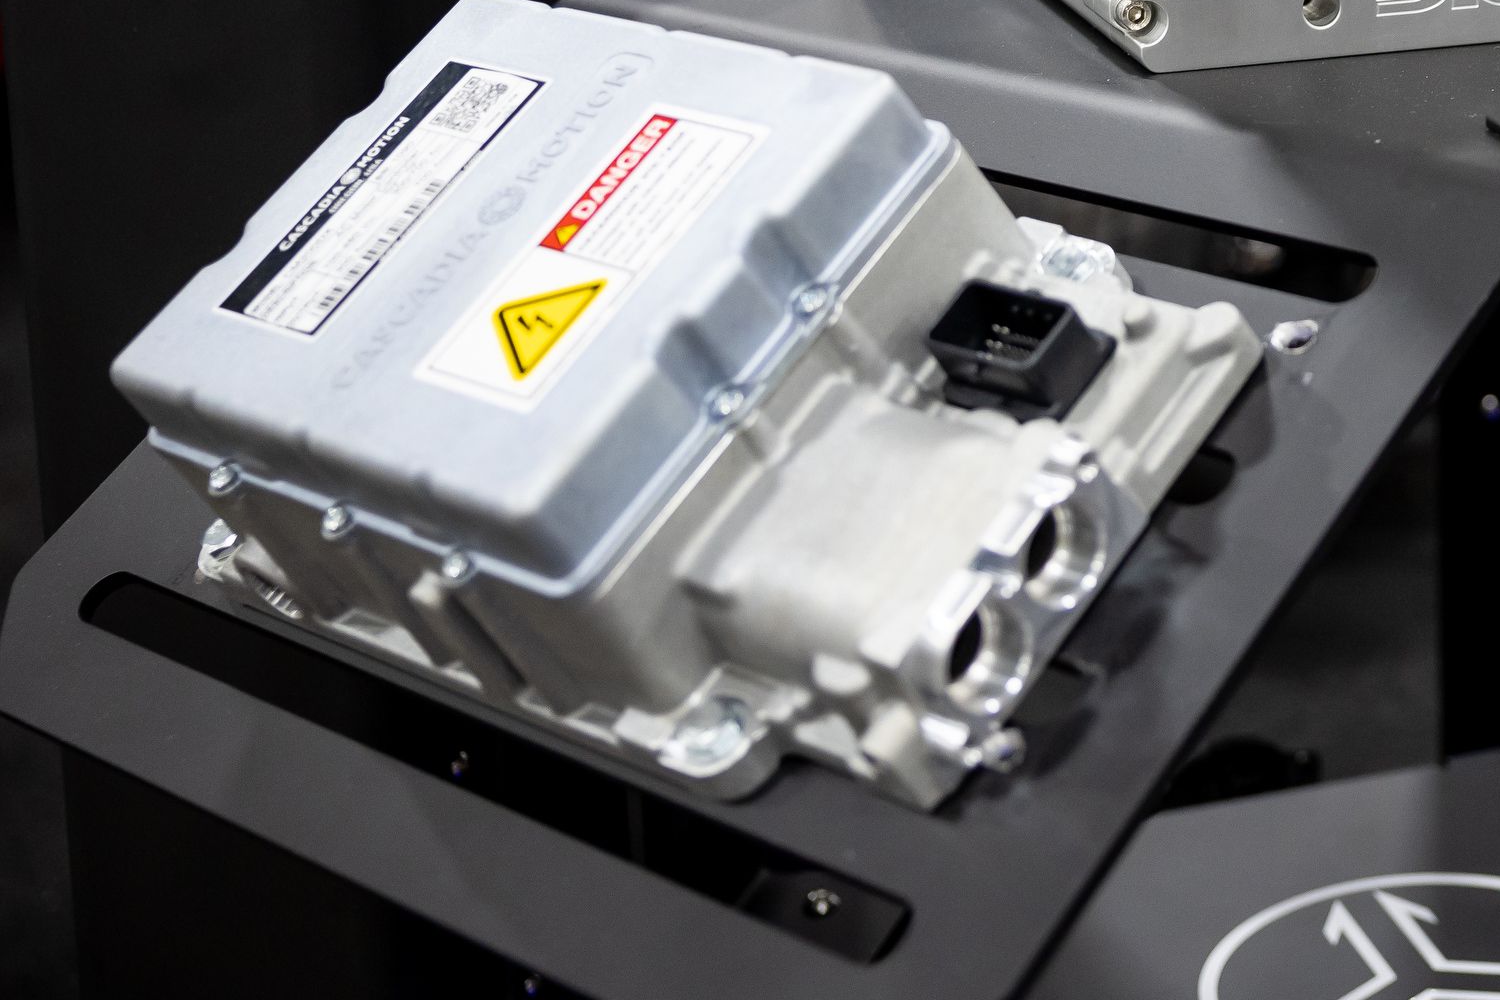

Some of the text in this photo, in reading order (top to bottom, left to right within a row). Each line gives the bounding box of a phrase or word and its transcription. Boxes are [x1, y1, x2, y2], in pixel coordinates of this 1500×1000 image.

[278, 184, 345, 252] CASCADIA
[356, 116, 411, 168] MOTION
[571, 116, 672, 221] DANGER
